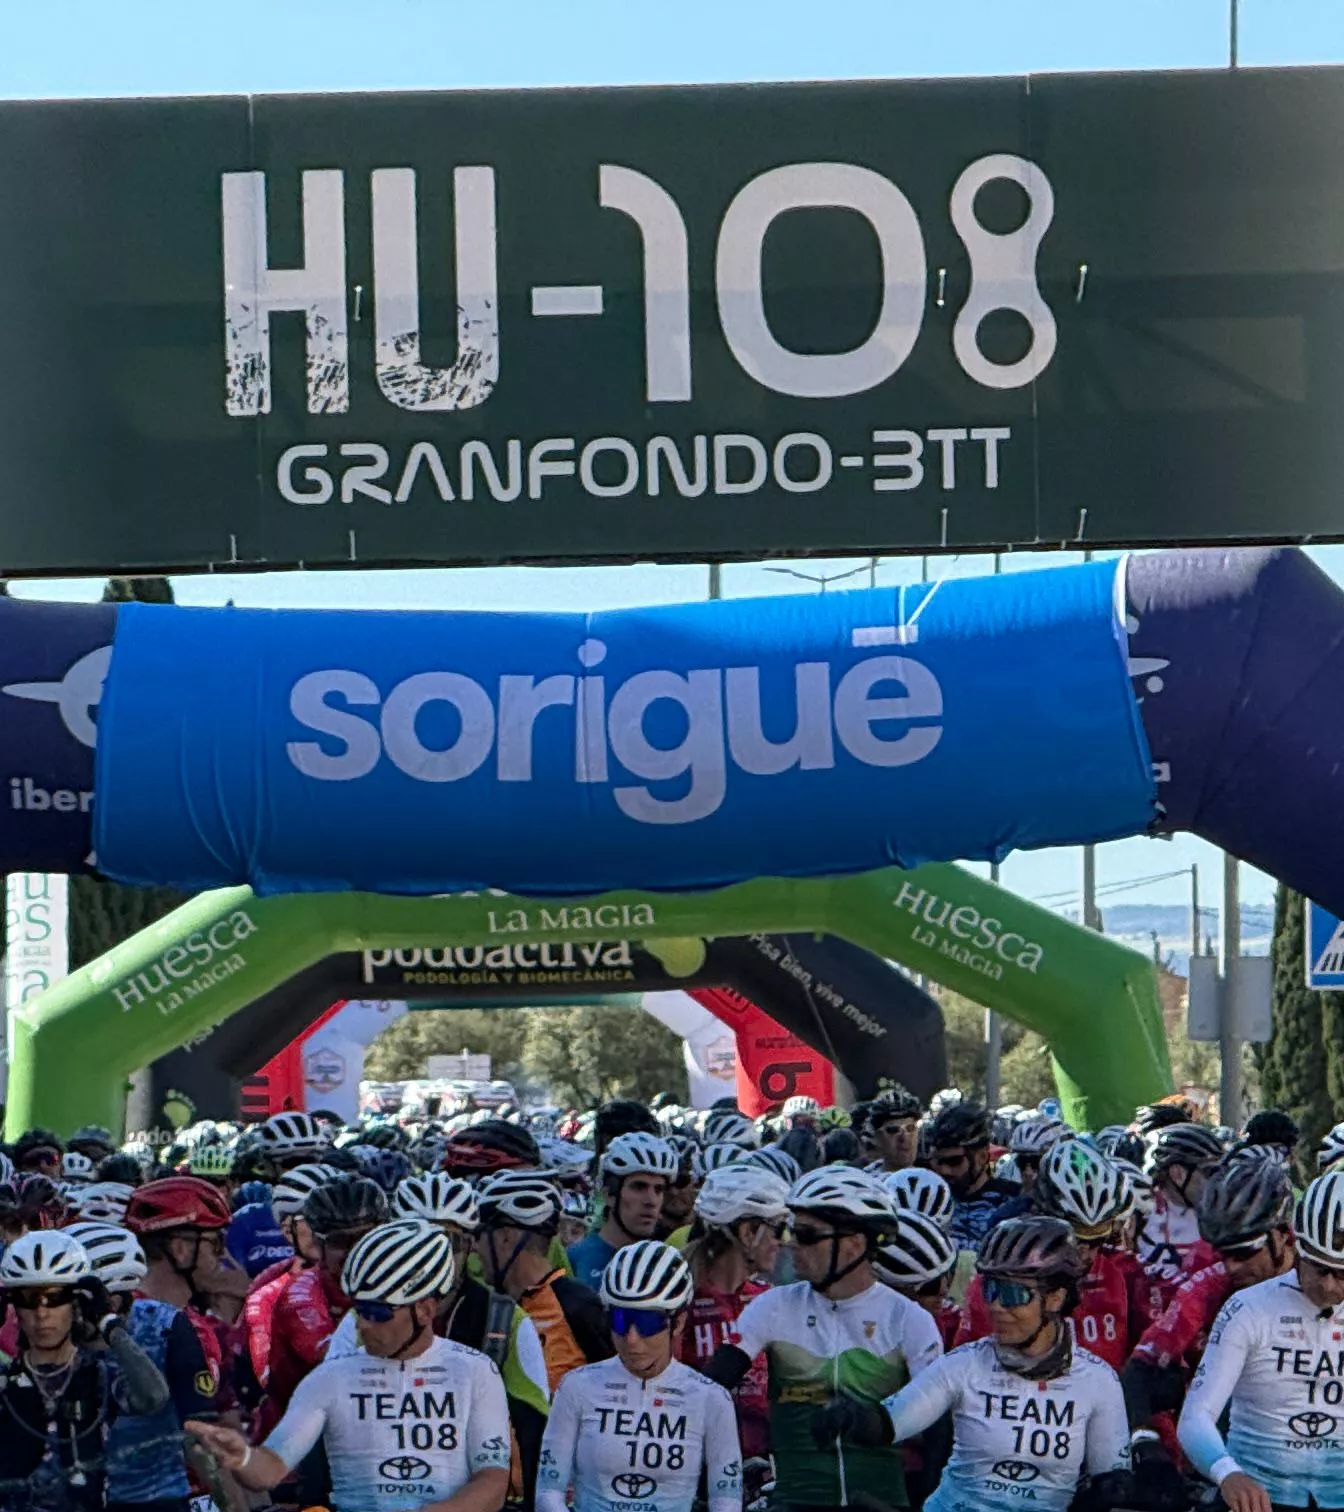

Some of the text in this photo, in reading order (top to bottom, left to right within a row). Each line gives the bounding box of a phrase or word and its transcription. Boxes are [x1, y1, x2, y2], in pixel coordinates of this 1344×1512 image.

[221, 153, 1057, 417] HU-108
[892, 880, 1045, 974] Huesca
[109, 911, 259, 1013] Huesca
[403, 969, 635, 985] PODOLOGÍA Y BIOMECÁNICA
[350, 1391, 456, 1420] TEAM
[979, 1391, 1075, 1428] TEAM
[391, 1424, 458, 1451] 108
[596, 1408, 686, 1441] TEAM
[626, 1441, 684, 1470] 108
[1011, 1425, 1071, 1460] 108
[1286, 1438, 1341, 1449] TOYOTA
[377, 1483, 436, 1495] TOYOTA
[984, 1479, 1037, 1499] TOYOTA
[609, 1502, 657, 1512] TOYOTA
